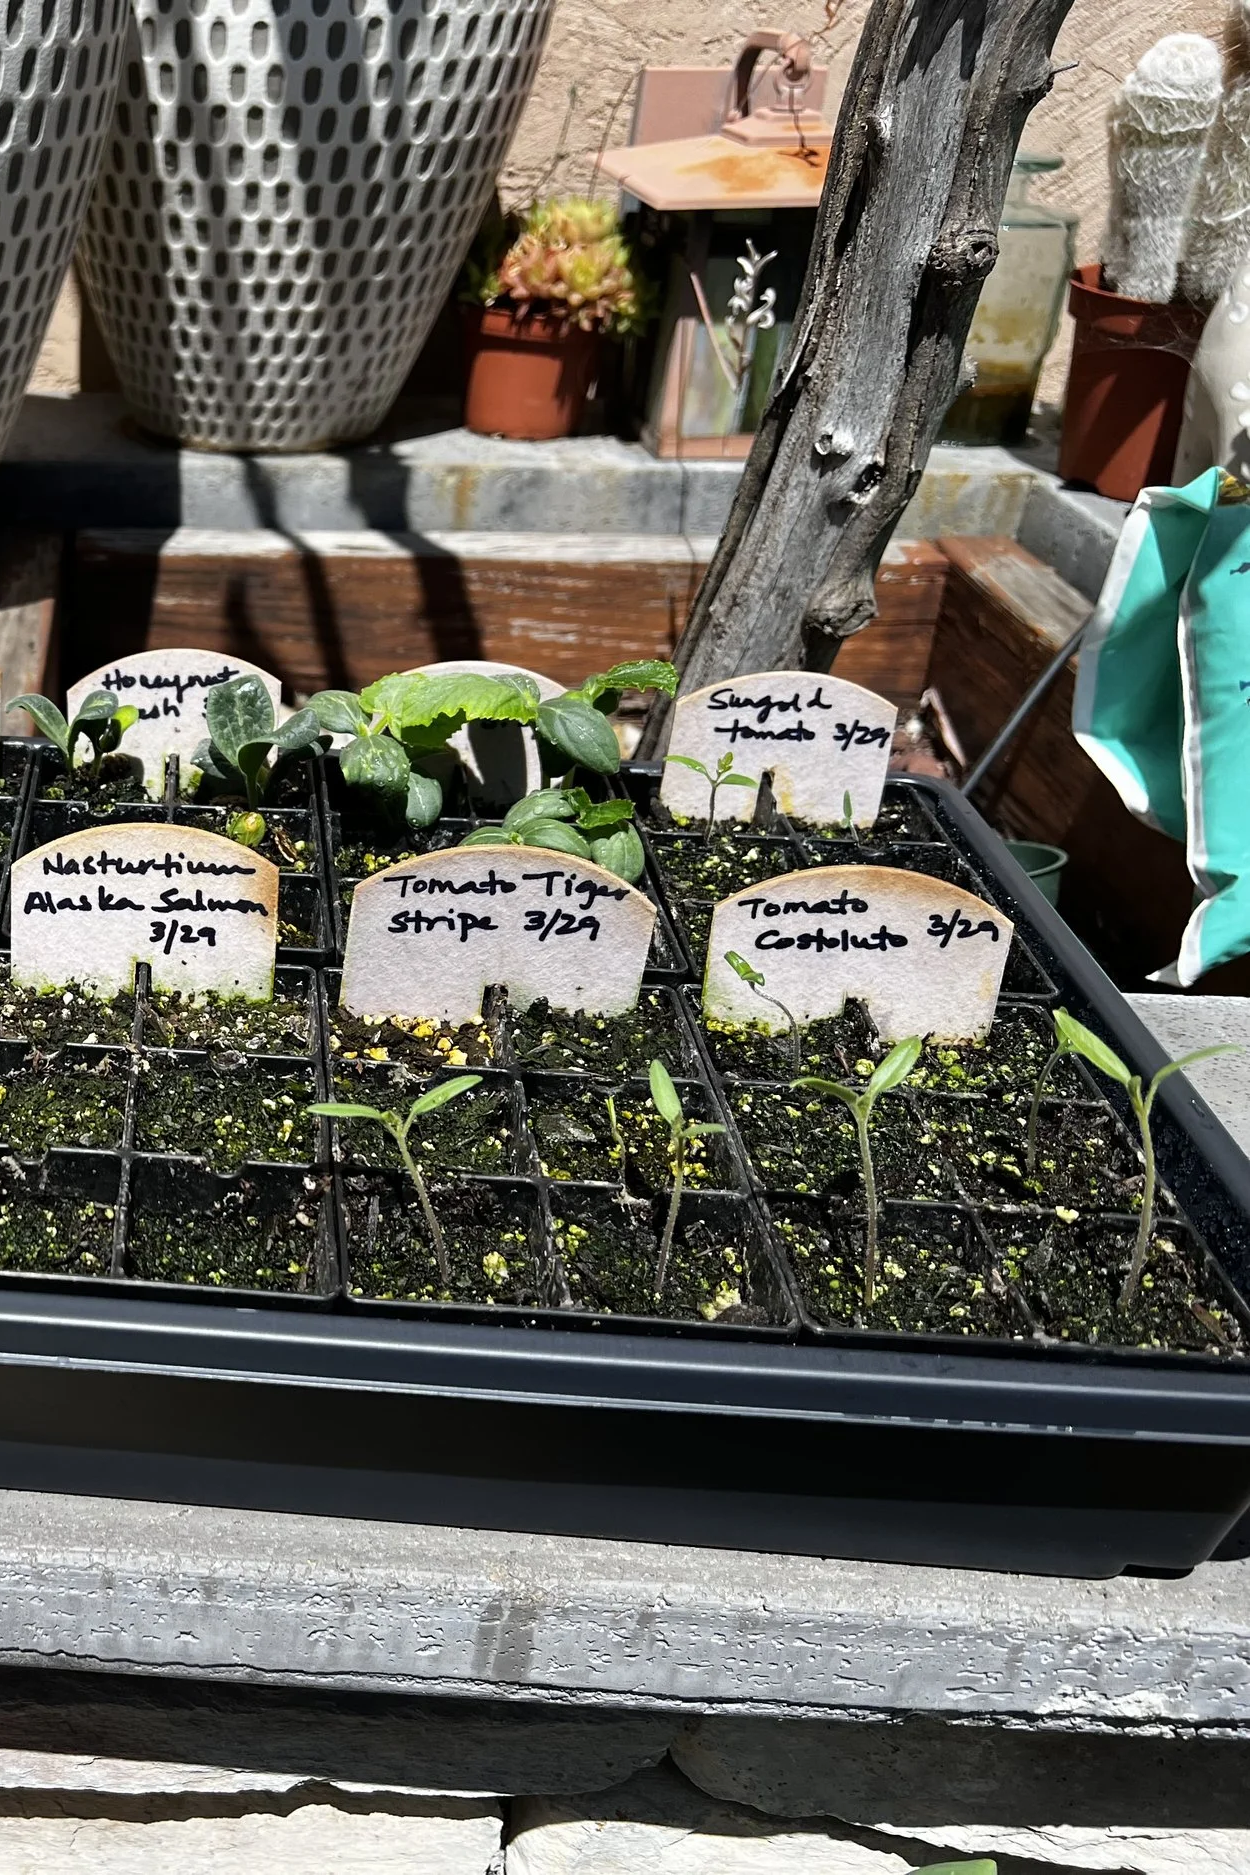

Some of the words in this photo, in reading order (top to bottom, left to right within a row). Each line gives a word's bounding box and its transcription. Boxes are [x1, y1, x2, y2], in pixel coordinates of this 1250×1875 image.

[833, 719, 890, 751] 3/29
[43, 850, 256, 878] Nasturtium
[24, 885, 145, 914] Alaska
[151, 888, 269, 916] Salmon
[383, 870, 517, 898] Tomato
[522, 871, 630, 910] Tiger
[523, 909, 600, 941] 3/29
[738, 890, 869, 919] Tomato
[927, 909, 999, 948] 3/29
[149, 920, 216, 954] 3/29
[755, 925, 908, 952] Costoluto
